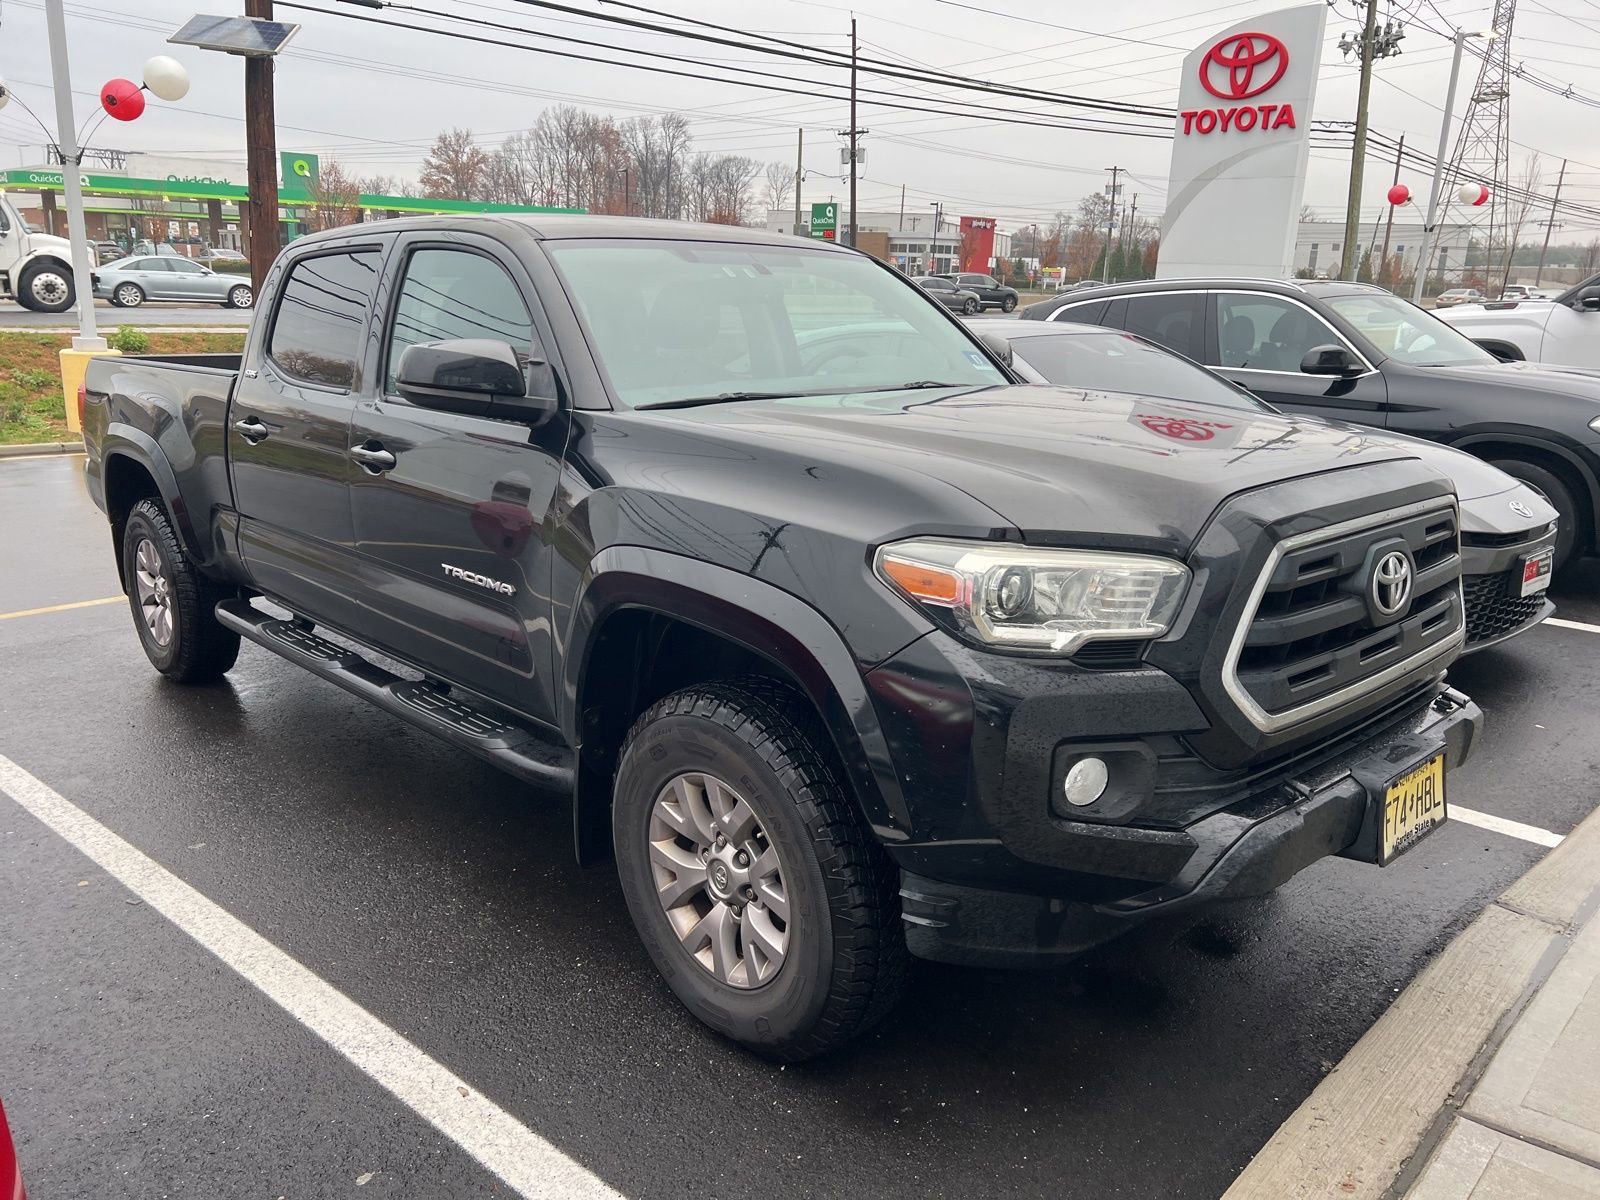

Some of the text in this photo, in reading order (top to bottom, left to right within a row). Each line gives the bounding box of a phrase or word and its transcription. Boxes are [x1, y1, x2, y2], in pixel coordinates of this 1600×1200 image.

[1180, 104, 1296, 135] TOYOTA
[29, 173, 64, 184] QuickCh
[441, 563, 516, 597] TACOMA
[1385, 790, 1407, 843] F74
[1416, 772, 1441, 820] HBL
[1414, 820, 1430, 834] State
